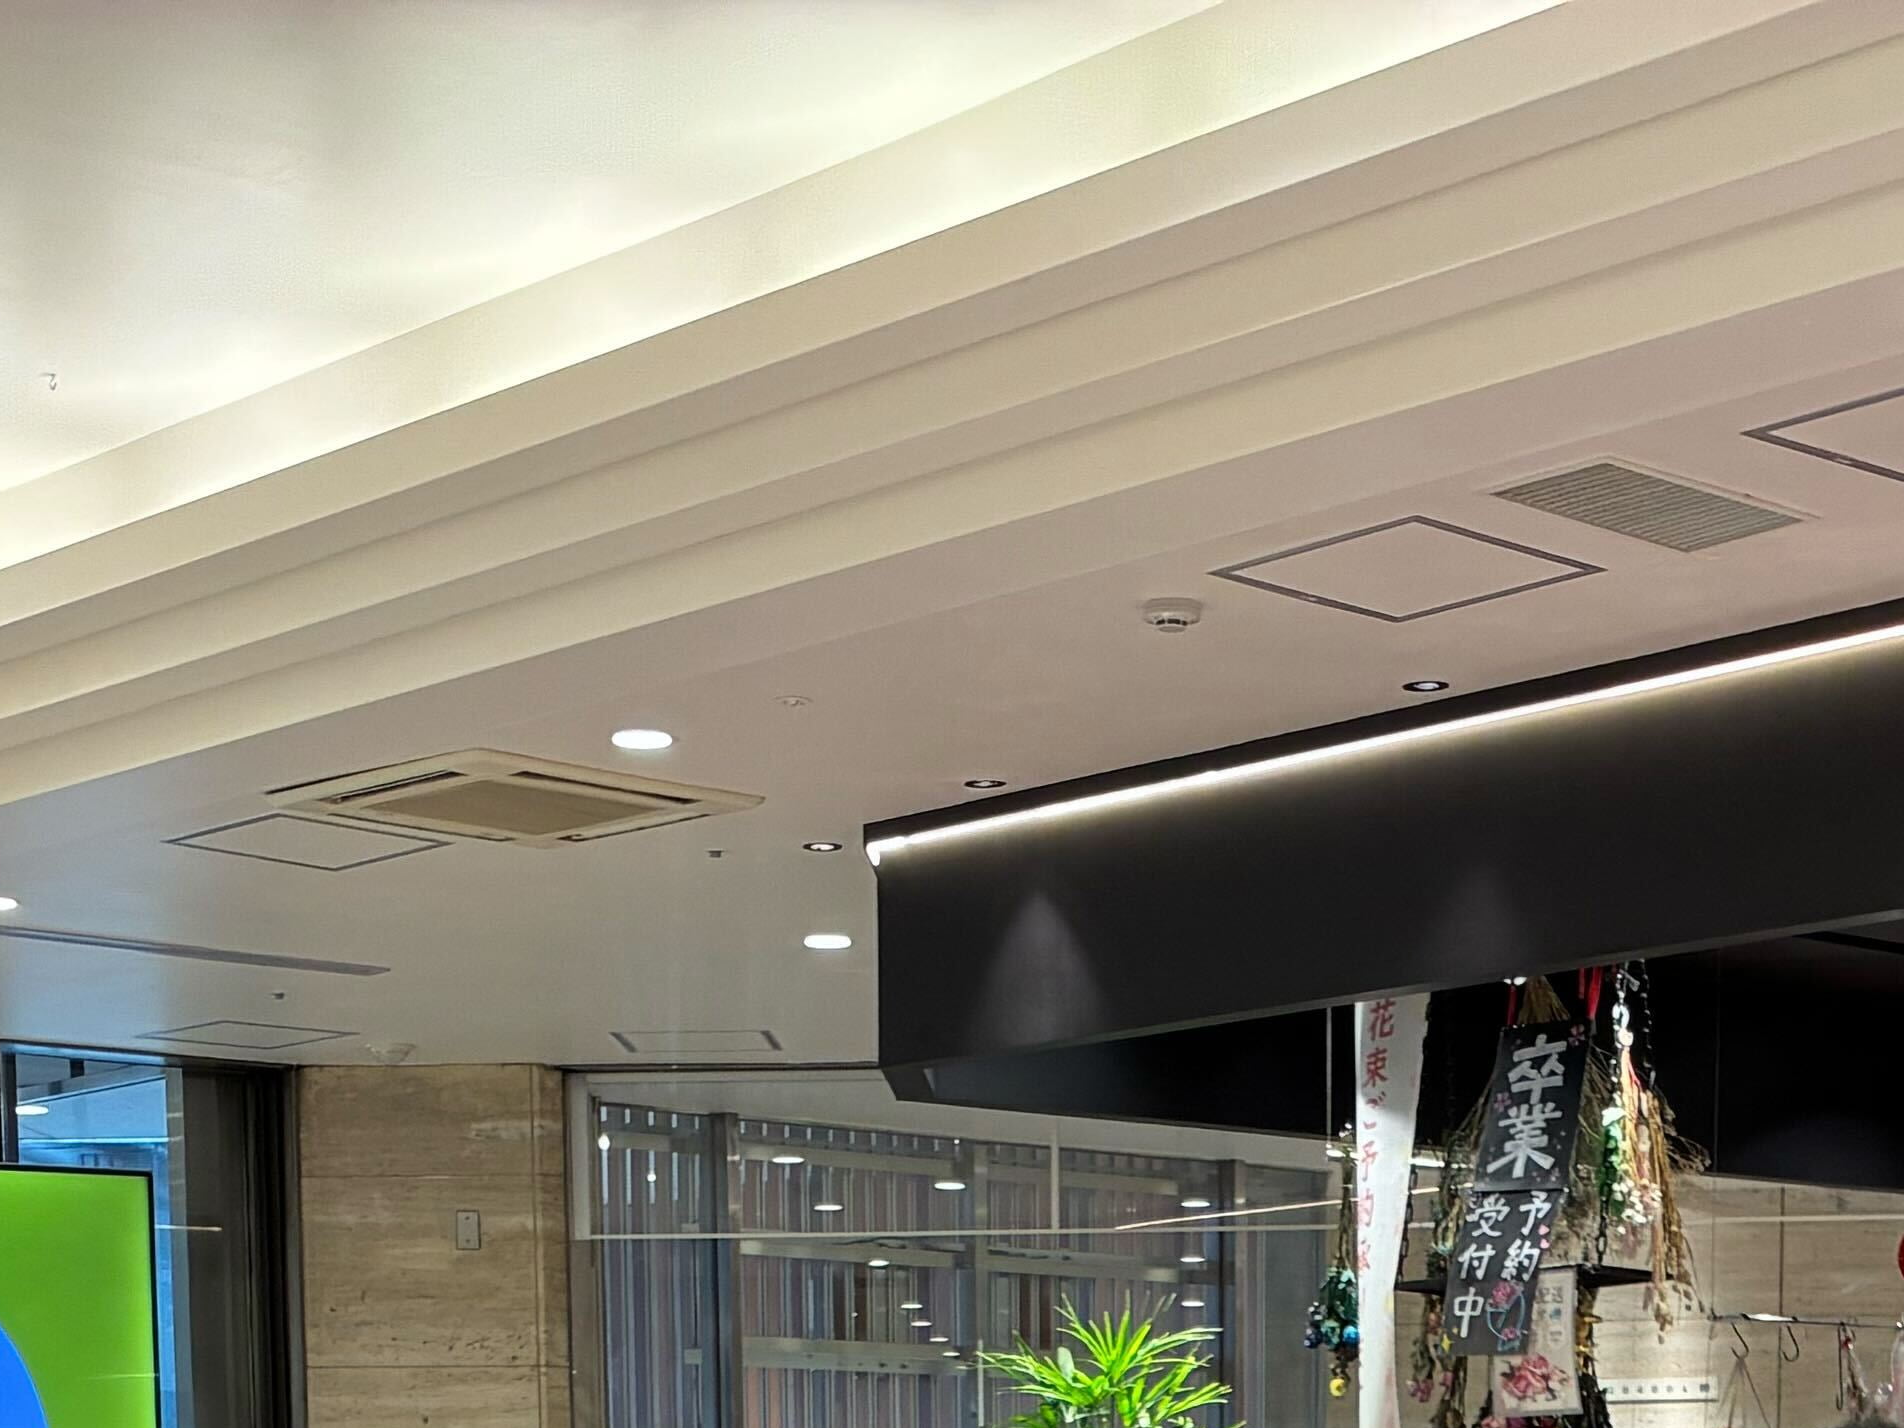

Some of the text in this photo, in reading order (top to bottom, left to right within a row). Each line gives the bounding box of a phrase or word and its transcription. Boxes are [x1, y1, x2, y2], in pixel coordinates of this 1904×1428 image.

[1486, 1034, 1567, 1180] 卒業
[1453, 1193, 1511, 1339] 受付中
[1500, 1190, 1552, 1283] 予約
